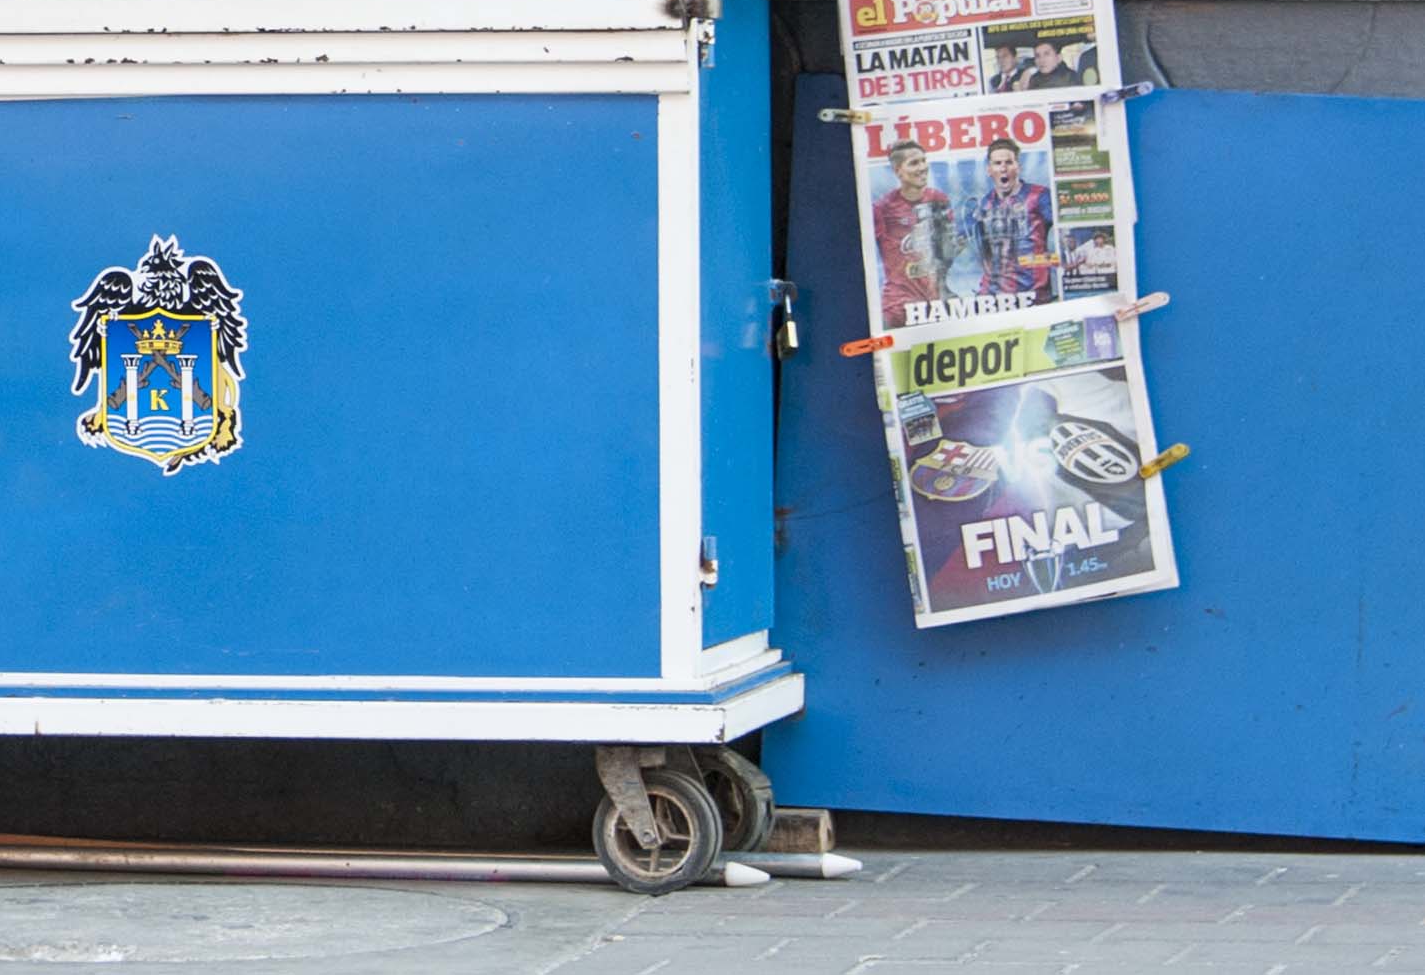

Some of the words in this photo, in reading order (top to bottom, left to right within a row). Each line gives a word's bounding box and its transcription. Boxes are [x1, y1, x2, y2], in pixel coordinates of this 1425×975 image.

[856, 0, 888, 28] el
[855, 52, 887, 74] LA
[889, 41, 970, 71] MATAN
[859, 76, 893, 99] DE
[894, 74, 906, 96] 3
[907, 65, 977, 93] TIROS
[864, 110, 1048, 159] LÍBERO
[903, 290, 1038, 326] HAMBRE
[913, 337, 1020, 388] depor
[150, 389, 169, 411] K
[960, 501, 1120, 570] FINAL
[986, 571, 1024, 592] HOY
